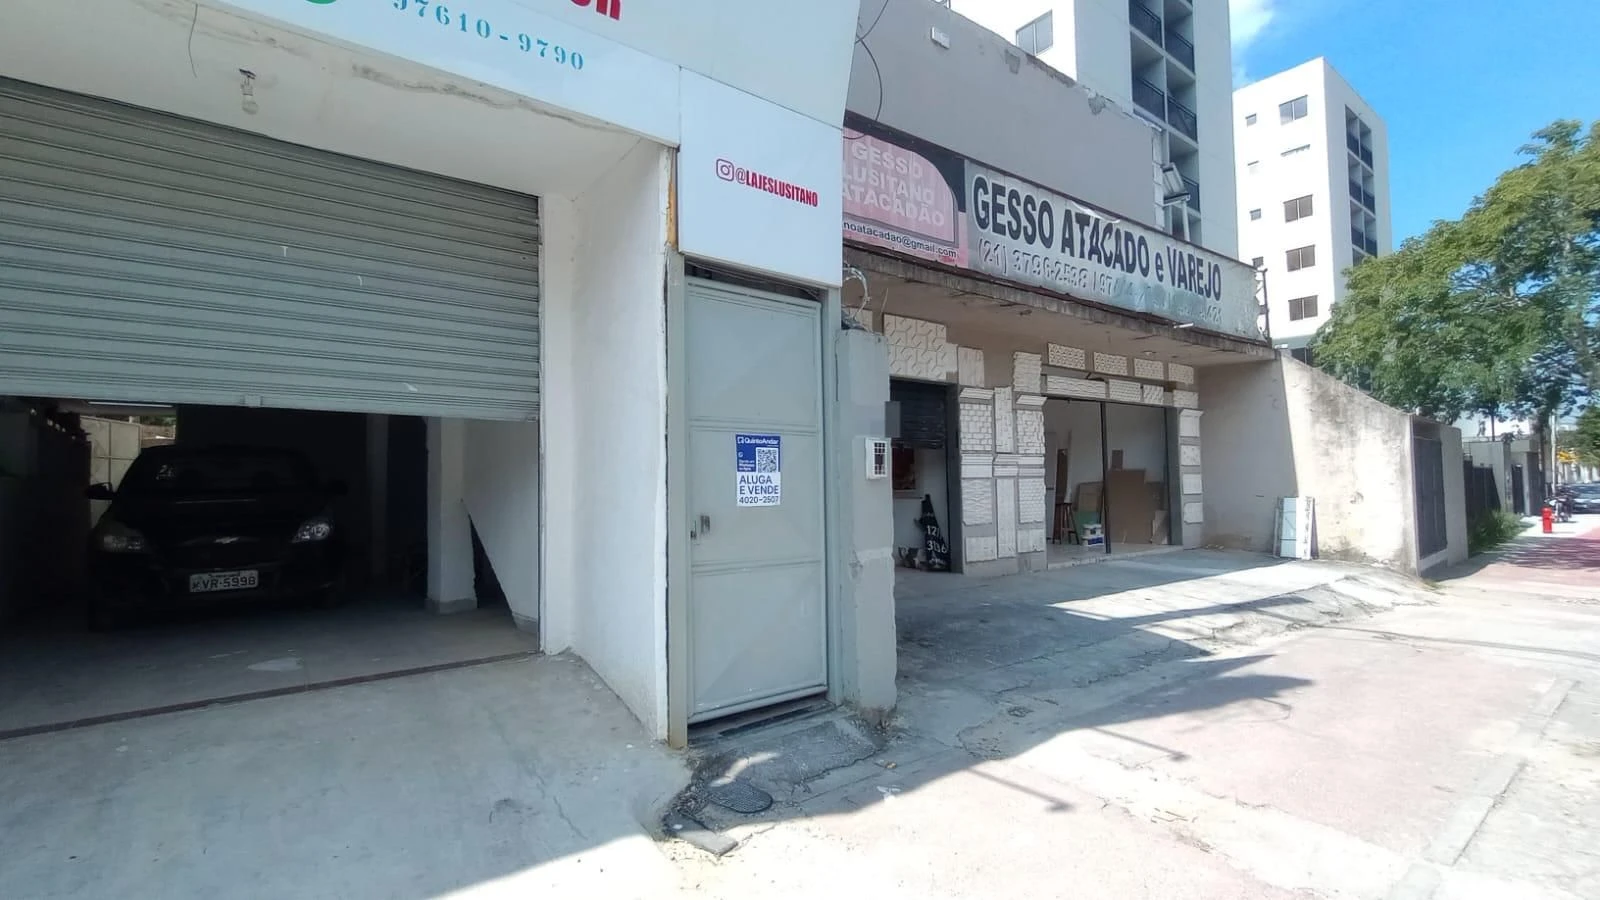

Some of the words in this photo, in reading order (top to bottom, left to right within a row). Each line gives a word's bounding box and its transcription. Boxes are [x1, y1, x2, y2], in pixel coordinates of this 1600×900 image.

[852, 141, 923, 178] GESSO
[736, 167, 818, 207] @LAJESLUSITANO
[973, 176, 1054, 249] GESSO
[1061, 209, 1150, 278] ATACADO
[1155, 252, 1164, 282] e
[1167, 246, 1221, 301] VAREJO
[739, 475, 773, 485] ALUGA
[739, 485, 746, 495] E
[748, 485, 779, 495] VENDE
